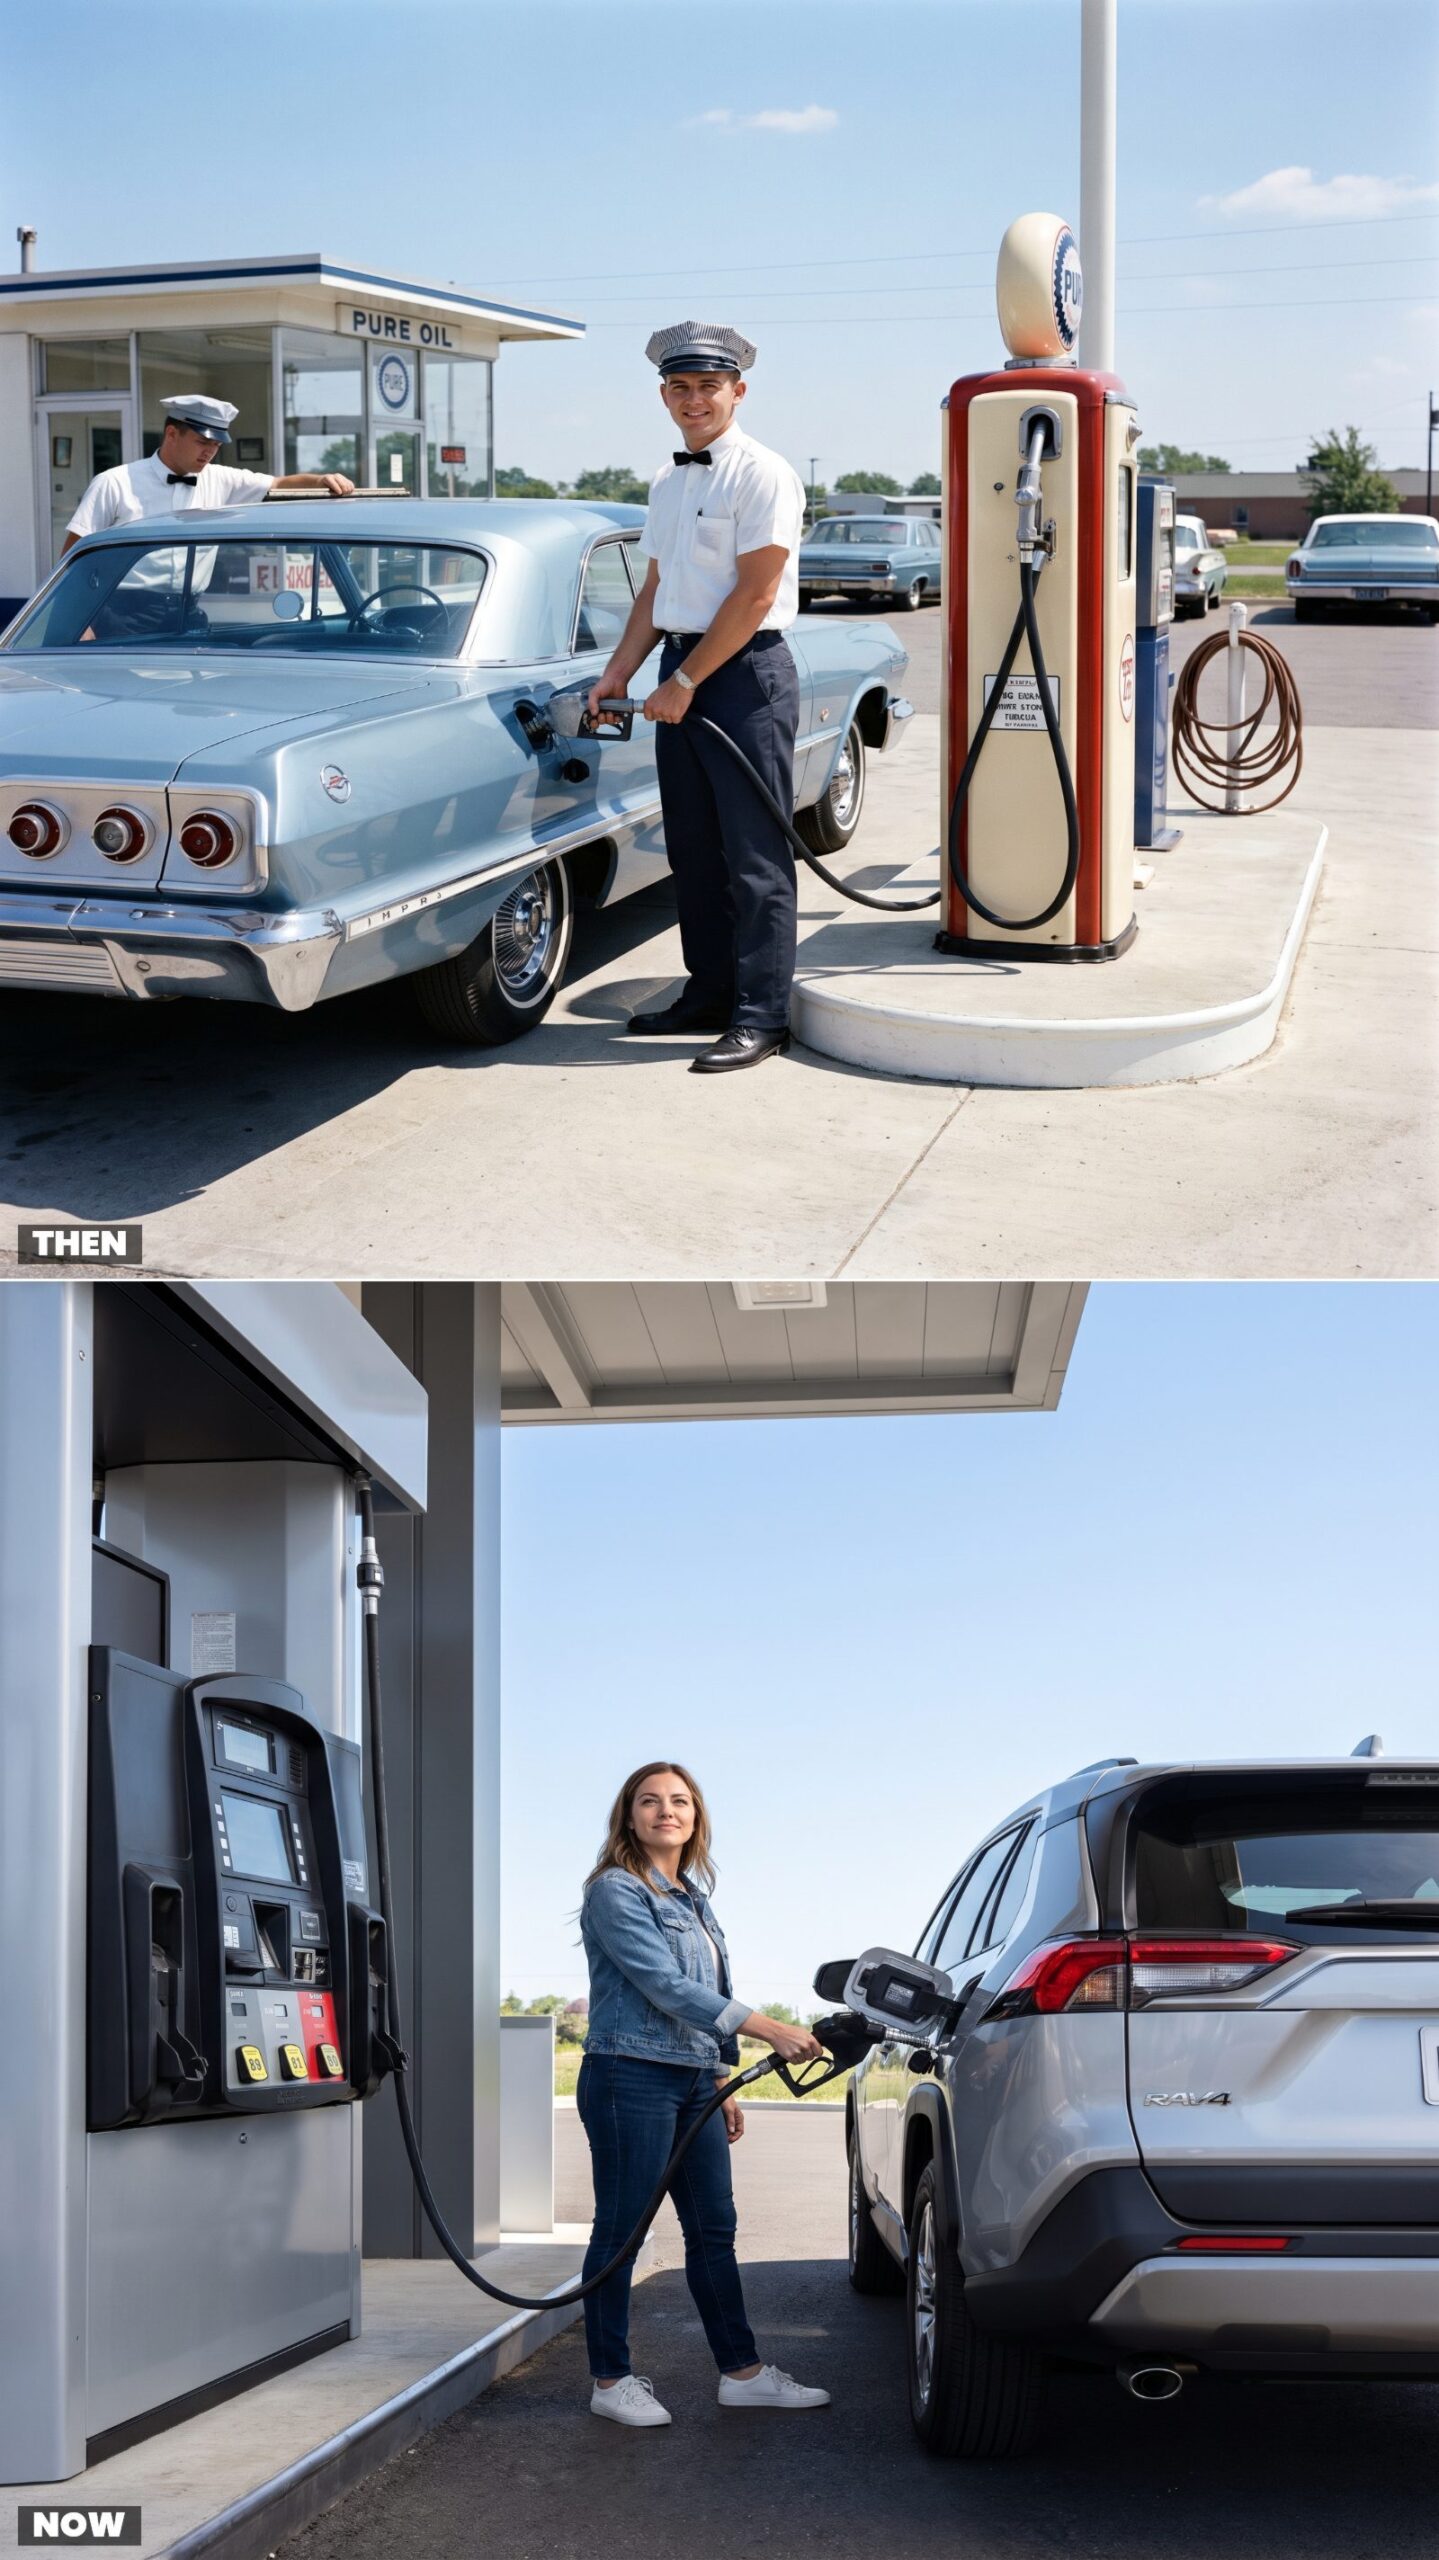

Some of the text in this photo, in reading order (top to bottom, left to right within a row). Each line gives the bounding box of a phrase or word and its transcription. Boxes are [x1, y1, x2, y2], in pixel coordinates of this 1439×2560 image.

[353, 311, 452, 347] PURE OIL
[384, 373, 404, 392] PURE
[249, 2058, 262, 2071] 89
[1144, 2091, 1231, 2106] RAV4
